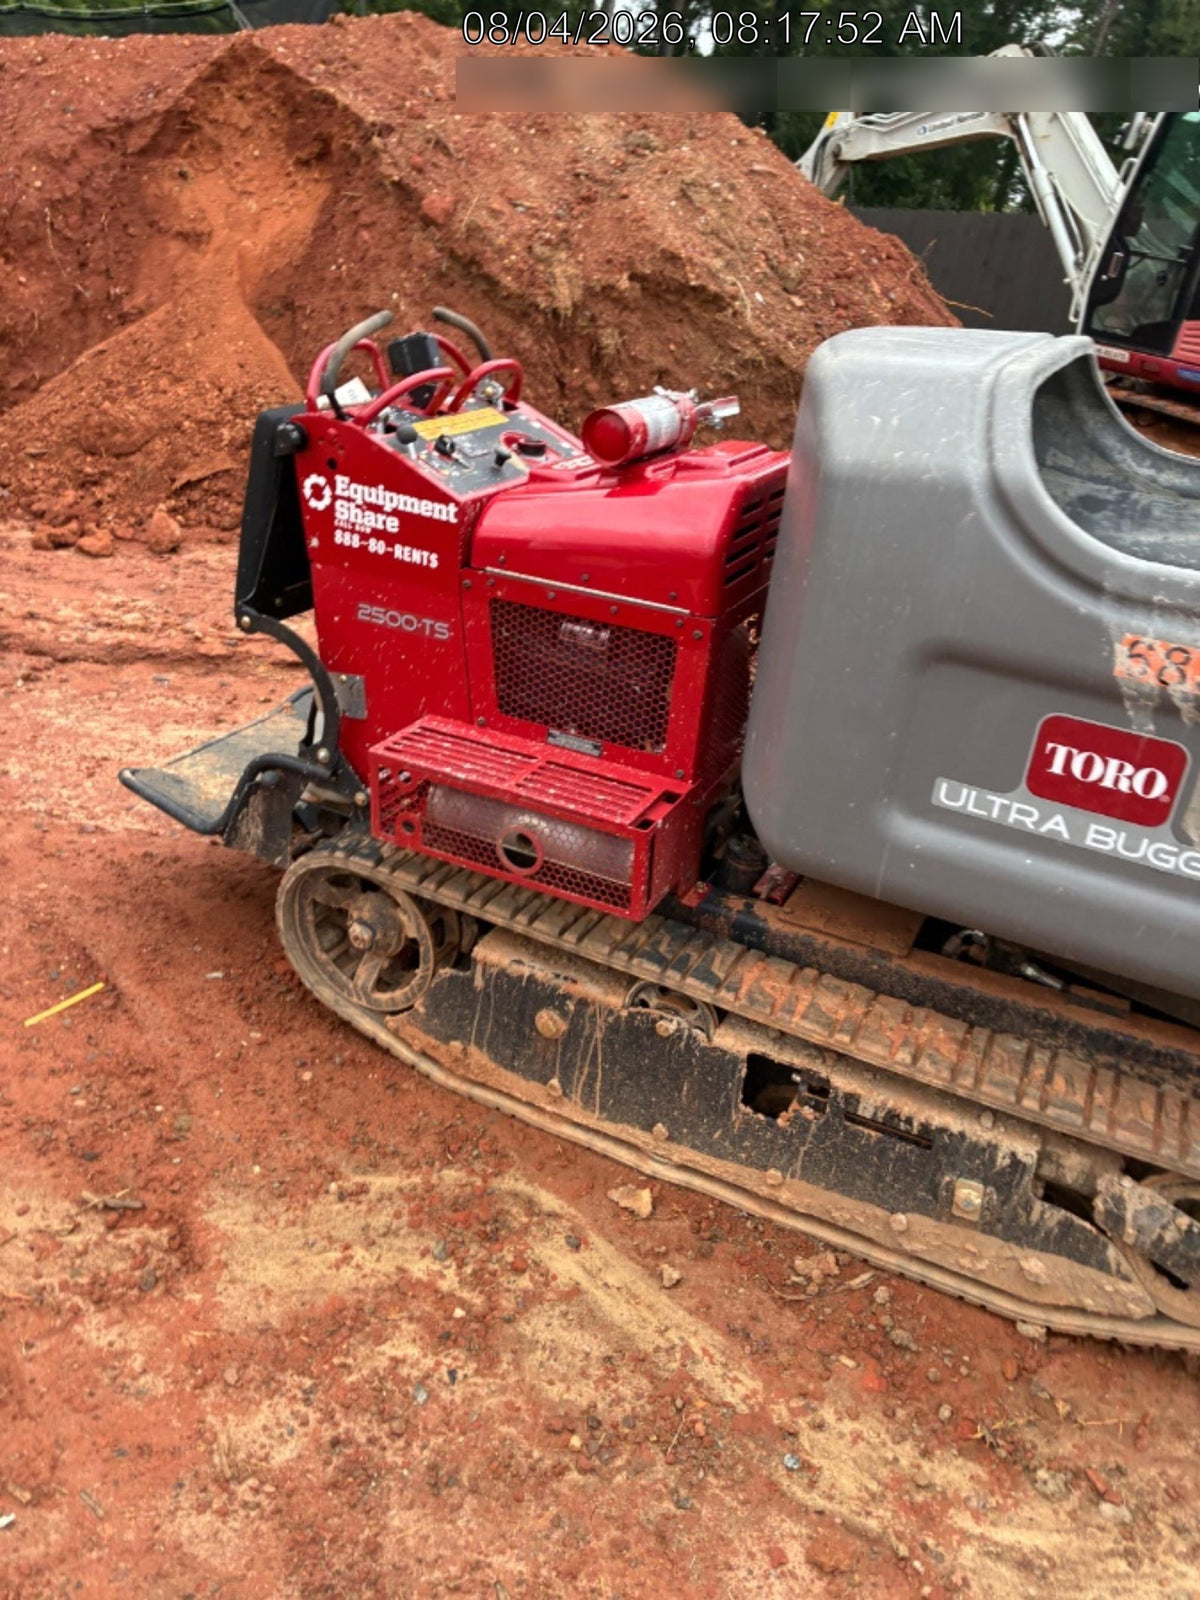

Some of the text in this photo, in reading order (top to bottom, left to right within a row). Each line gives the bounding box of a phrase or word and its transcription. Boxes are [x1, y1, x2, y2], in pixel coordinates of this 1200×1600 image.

[334, 474, 459, 523] Equipment
[334, 499, 400, 533] Share
[334, 529, 439, 569] 888-80-RENTS
[1044, 742, 1169, 800] TORO
[938, 781, 1071, 840] ULTRA
